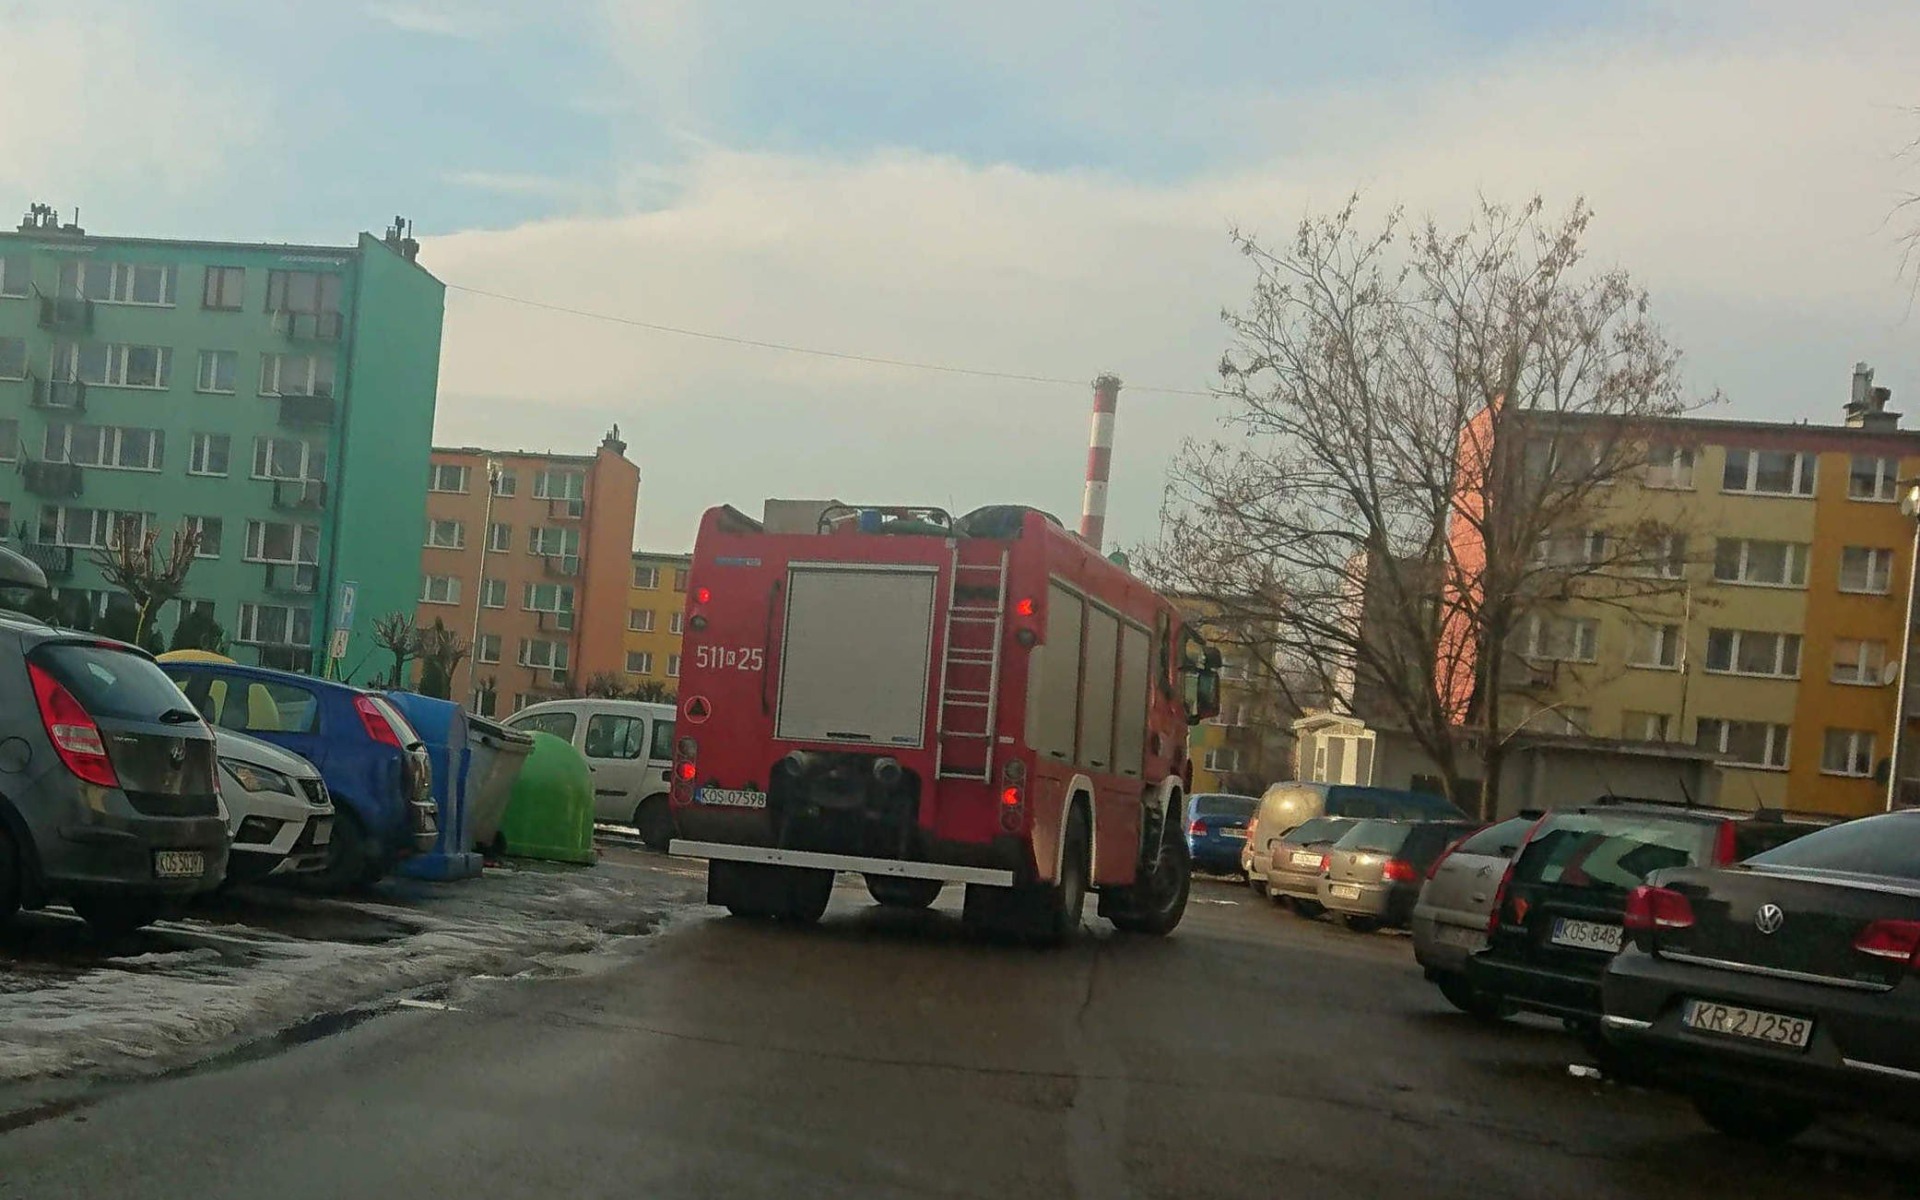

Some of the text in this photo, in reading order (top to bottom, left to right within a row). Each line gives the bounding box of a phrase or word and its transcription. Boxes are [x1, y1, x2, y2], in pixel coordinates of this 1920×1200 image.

[702, 788, 765, 806] KOS 07598
[1562, 921, 1588, 941] KOS
[1694, 1003, 1805, 1044] KR 2J258
